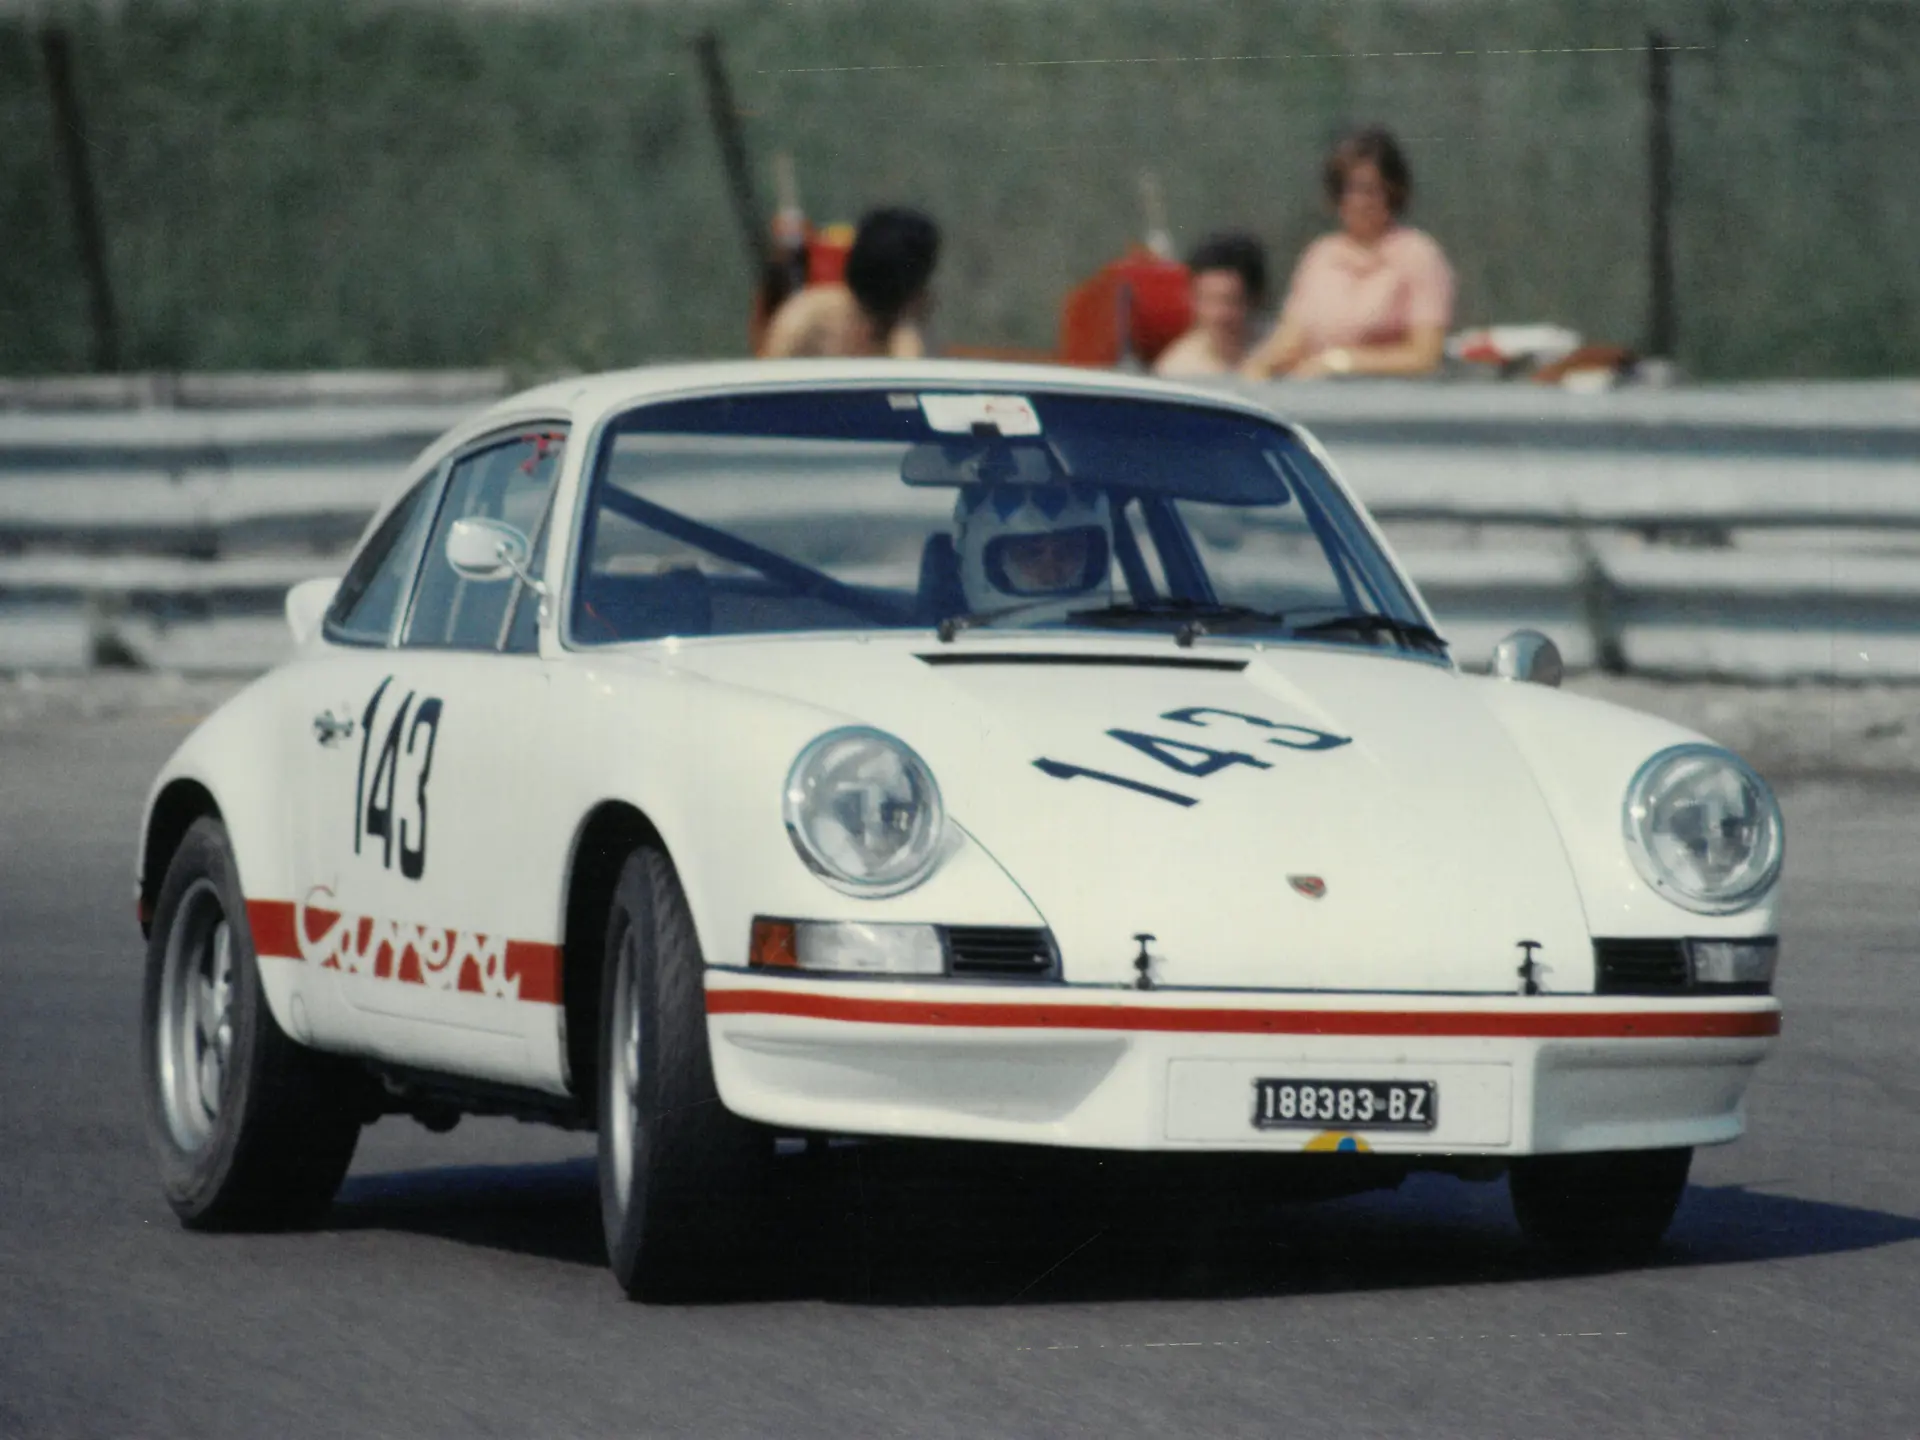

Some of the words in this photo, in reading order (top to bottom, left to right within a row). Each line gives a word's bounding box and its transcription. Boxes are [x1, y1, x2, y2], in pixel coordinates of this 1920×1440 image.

[354, 674, 443, 880] 143
[1030, 706, 1353, 807] 143
[295, 886, 521, 1000] Carrera
